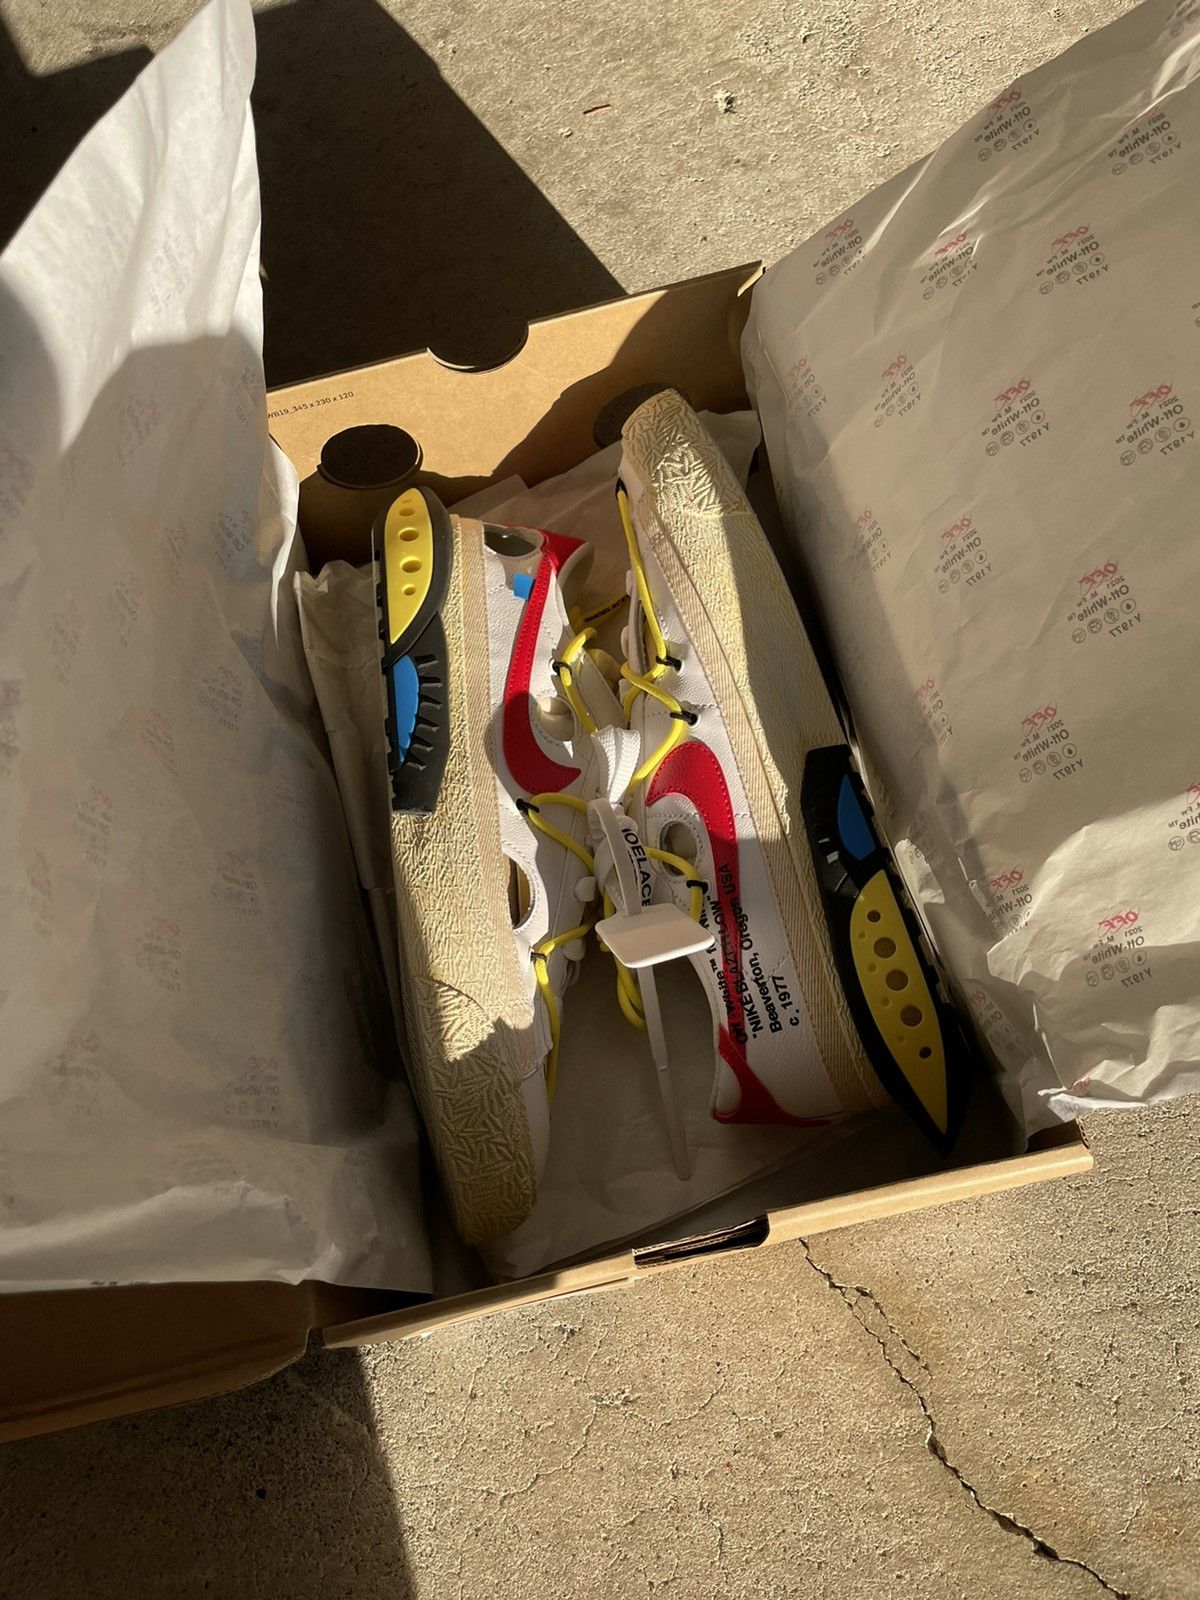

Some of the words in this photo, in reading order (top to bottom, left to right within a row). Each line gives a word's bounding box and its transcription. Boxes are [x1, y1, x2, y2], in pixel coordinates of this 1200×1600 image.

[315, 397, 332, 406] 230
[338, 391, 354, 400] 120
[719, 862, 736, 895] USA
[730, 896, 753, 951] Oregon
[749, 952, 783, 1033] Beaverton,
[771, 975, 793, 1010] 1977
